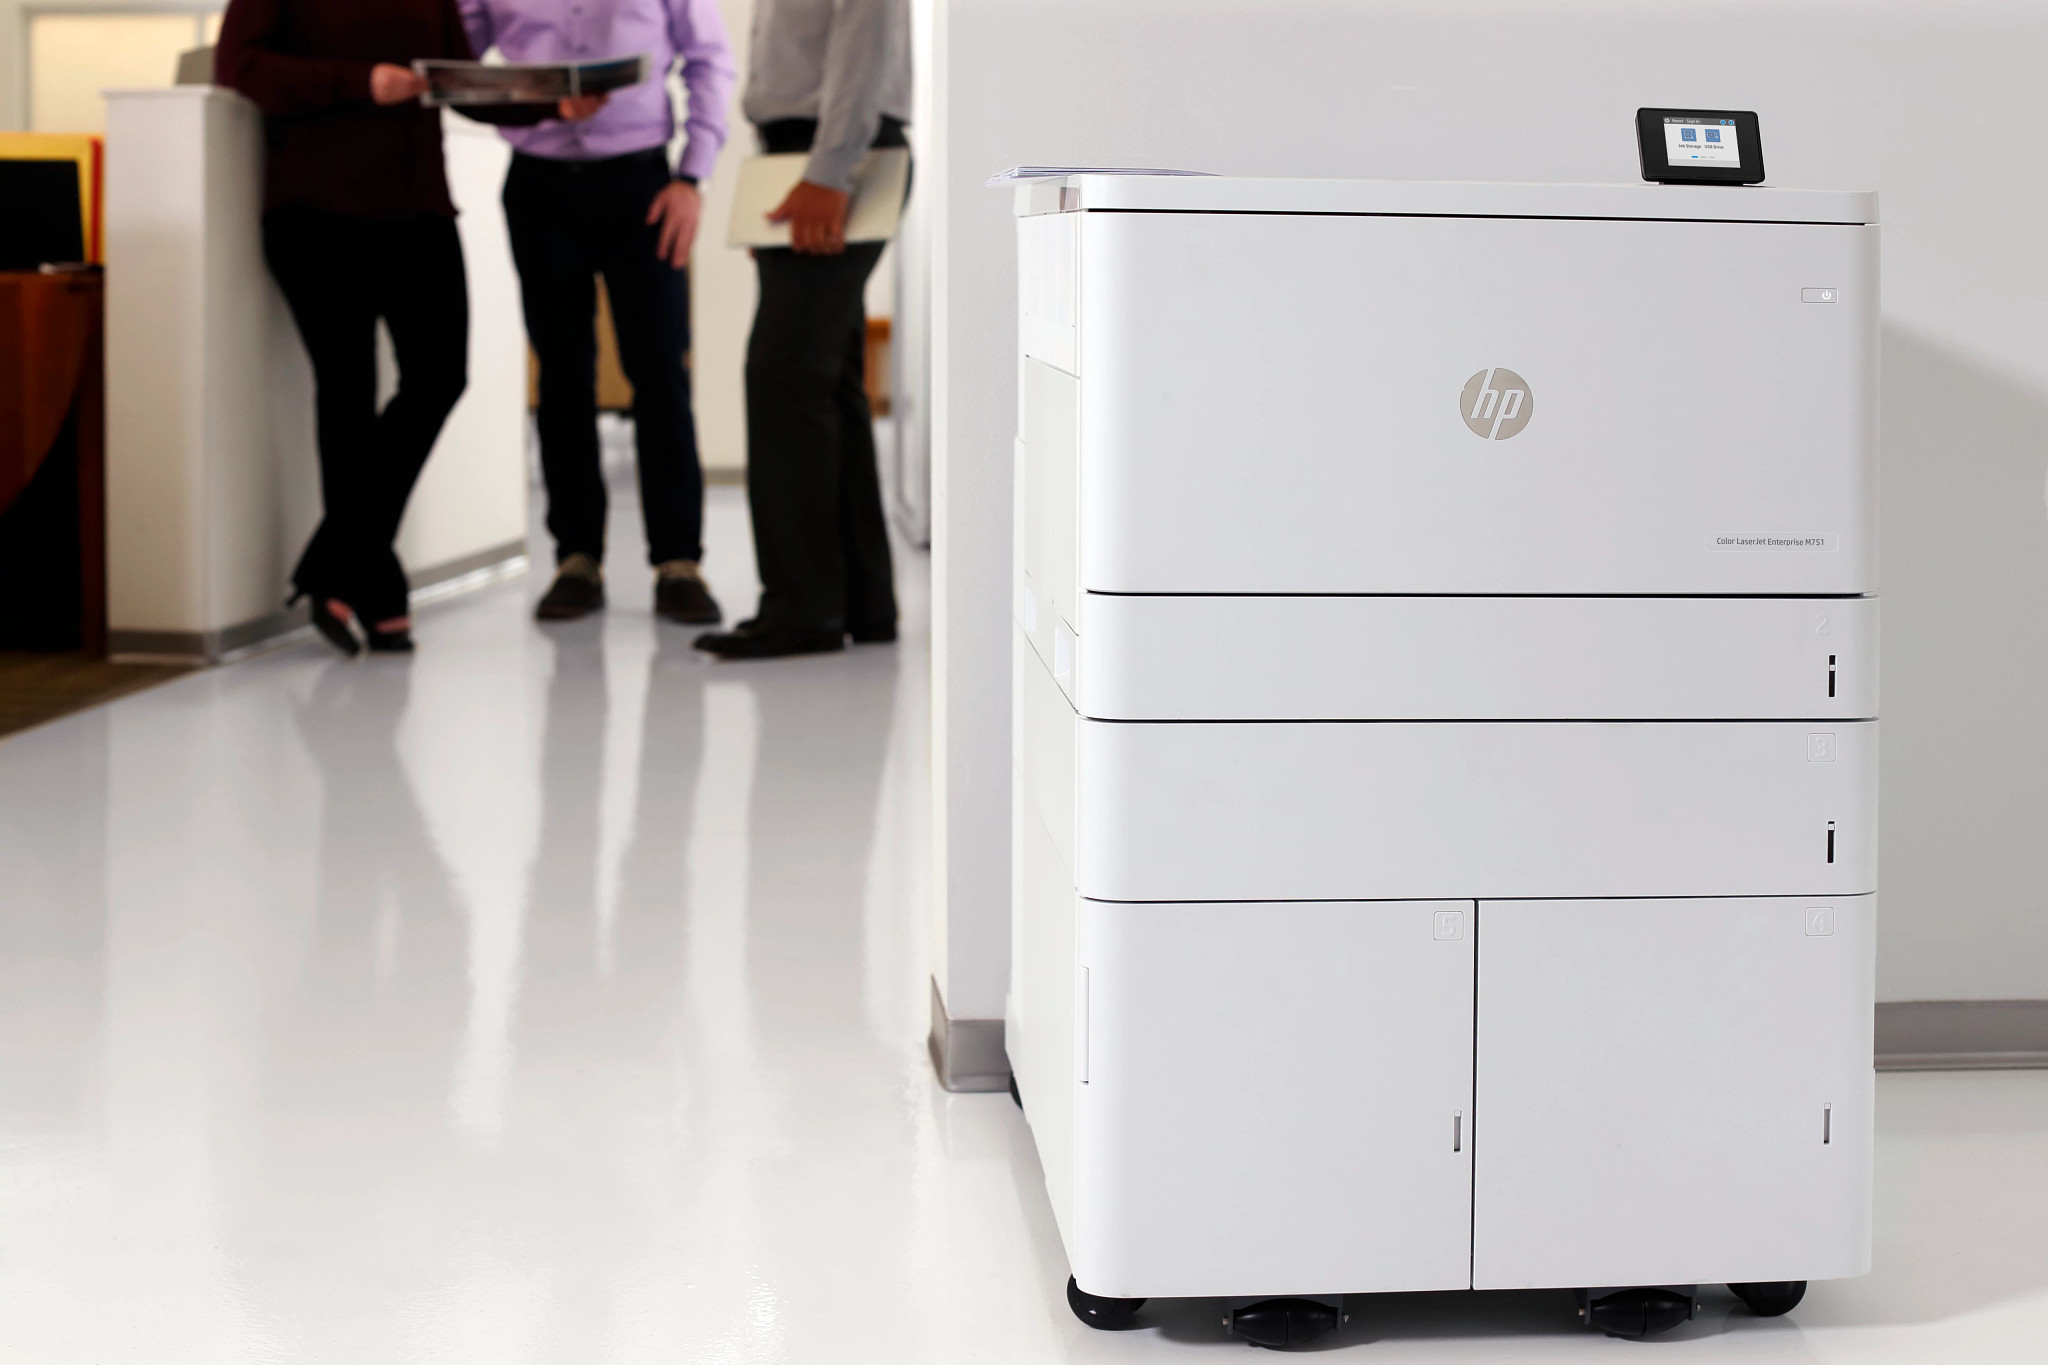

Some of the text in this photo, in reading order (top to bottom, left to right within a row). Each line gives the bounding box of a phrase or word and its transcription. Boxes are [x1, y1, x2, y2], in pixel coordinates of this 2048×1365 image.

[1468, 367, 1526, 440] hp
[1716, 537, 1824, 547] Color LaserJet Enterprise M751
[1815, 613, 1830, 636] 2
[1814, 736, 1828, 759] 3
[1441, 914, 1457, 937] 5
[1812, 911, 1827, 933] 4
